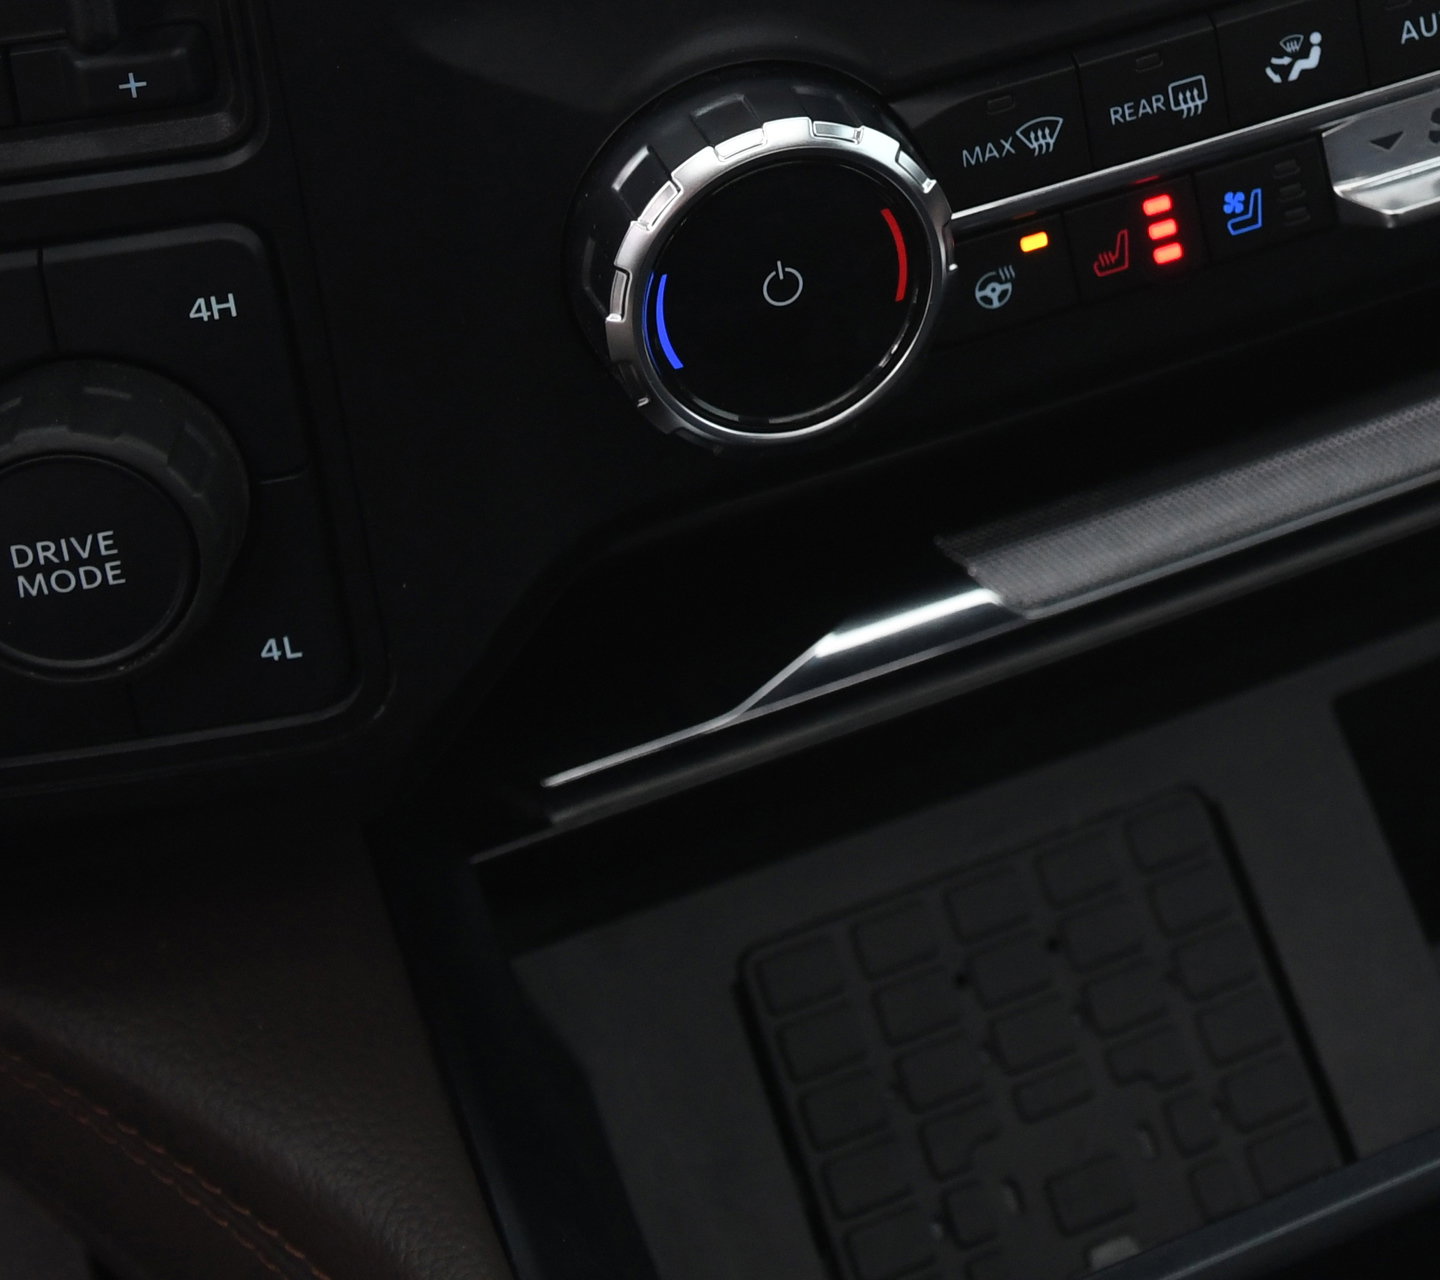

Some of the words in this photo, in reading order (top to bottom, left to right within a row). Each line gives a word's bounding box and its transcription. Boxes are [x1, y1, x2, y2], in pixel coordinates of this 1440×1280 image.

[1110, 95, 1165, 125] REAR
[962, 137, 1016, 168] MAX
[190, 293, 237, 321] 4H
[10, 529, 120, 569] DRIVE
[16, 560, 127, 599] MODE
[261, 637, 302, 660] 4L
